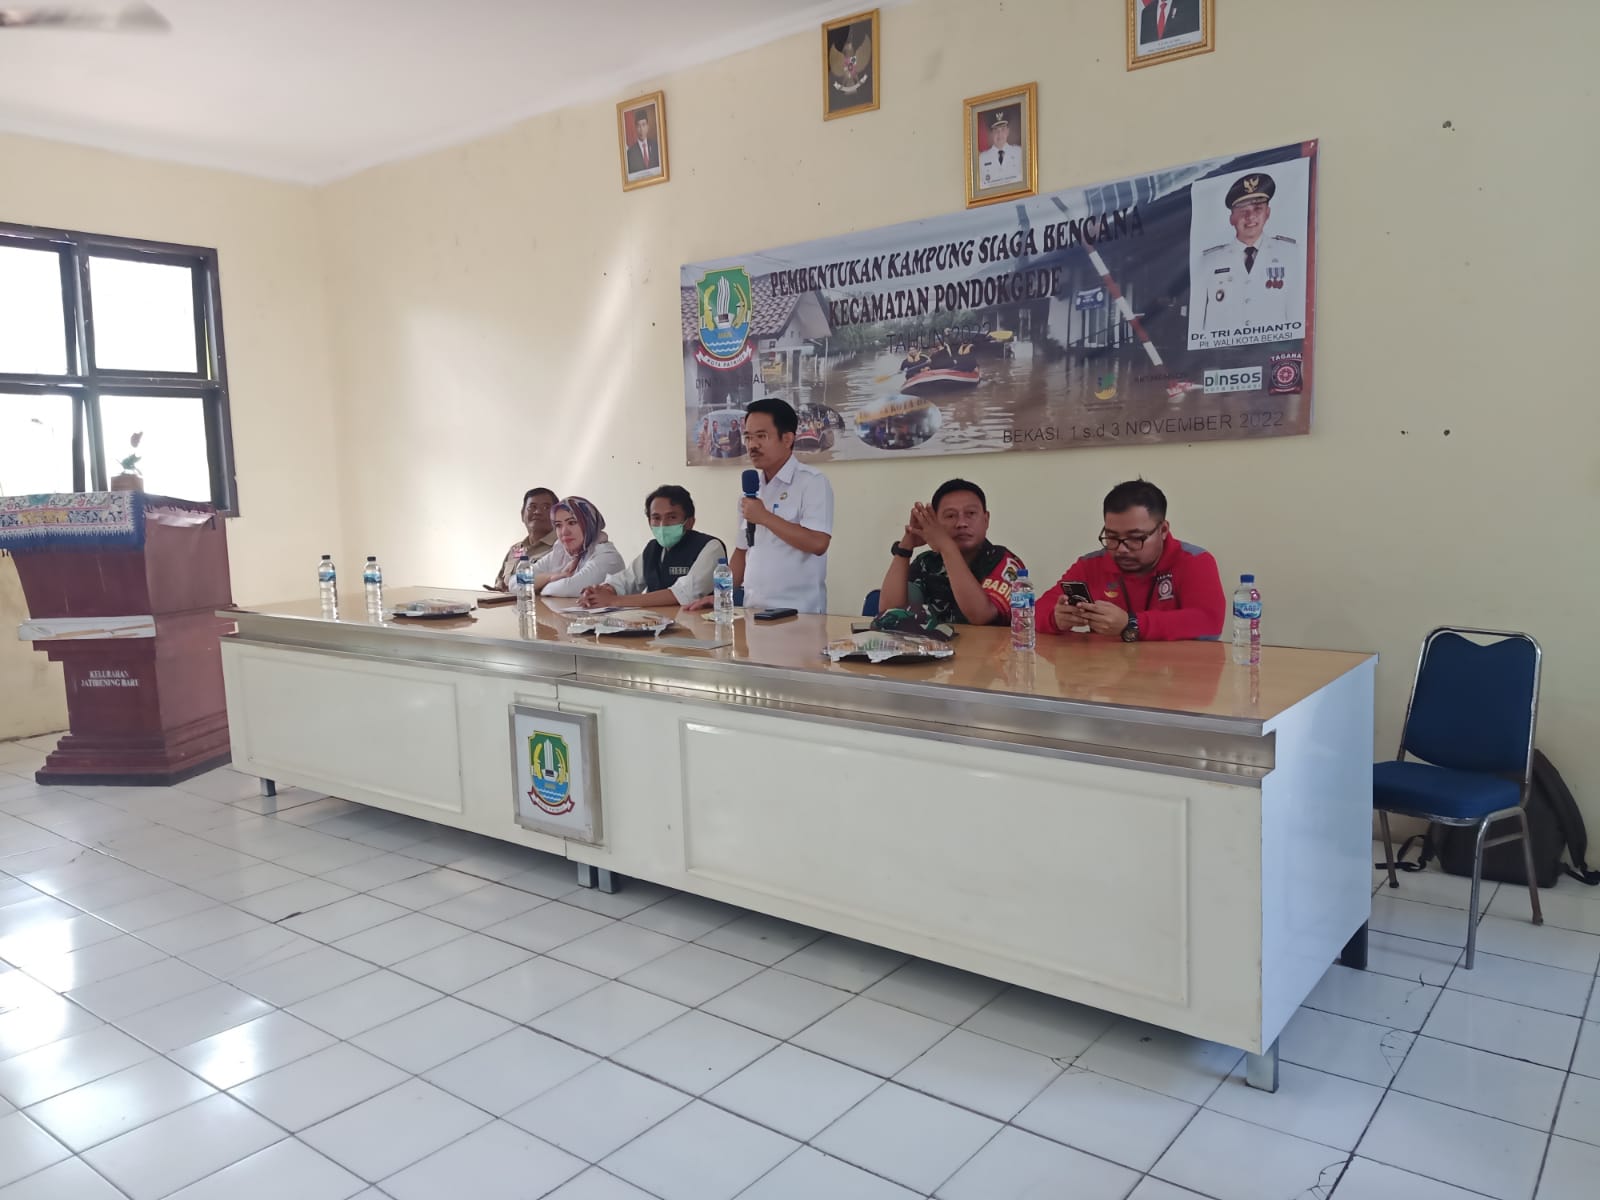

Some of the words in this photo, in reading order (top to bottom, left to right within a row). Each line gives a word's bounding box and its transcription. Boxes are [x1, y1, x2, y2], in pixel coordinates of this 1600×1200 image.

[770, 255, 886, 297] PEMBENTUKAN
[887, 239, 975, 280] KAMPUNG
[978, 228, 1038, 264] SIAGA
[1043, 206, 1145, 254] BENCANA
[828, 286, 929, 328] KECAMATAN
[1191, 333, 1207, 341] Dr.
[1210, 329, 1230, 339] TRI
[1233, 321, 1302, 336] ADHIANTO
[1213, 338, 1234, 347] WALI
[1236, 335, 1260, 345] KOTA
[1261, 332, 1293, 343] BEKASI
[1271, 353, 1302, 362] TAGANA
[1111, 422, 1120, 437] 3
[1126, 414, 1232, 436] NOVEMBER
[1239, 411, 1285, 429] 2022
